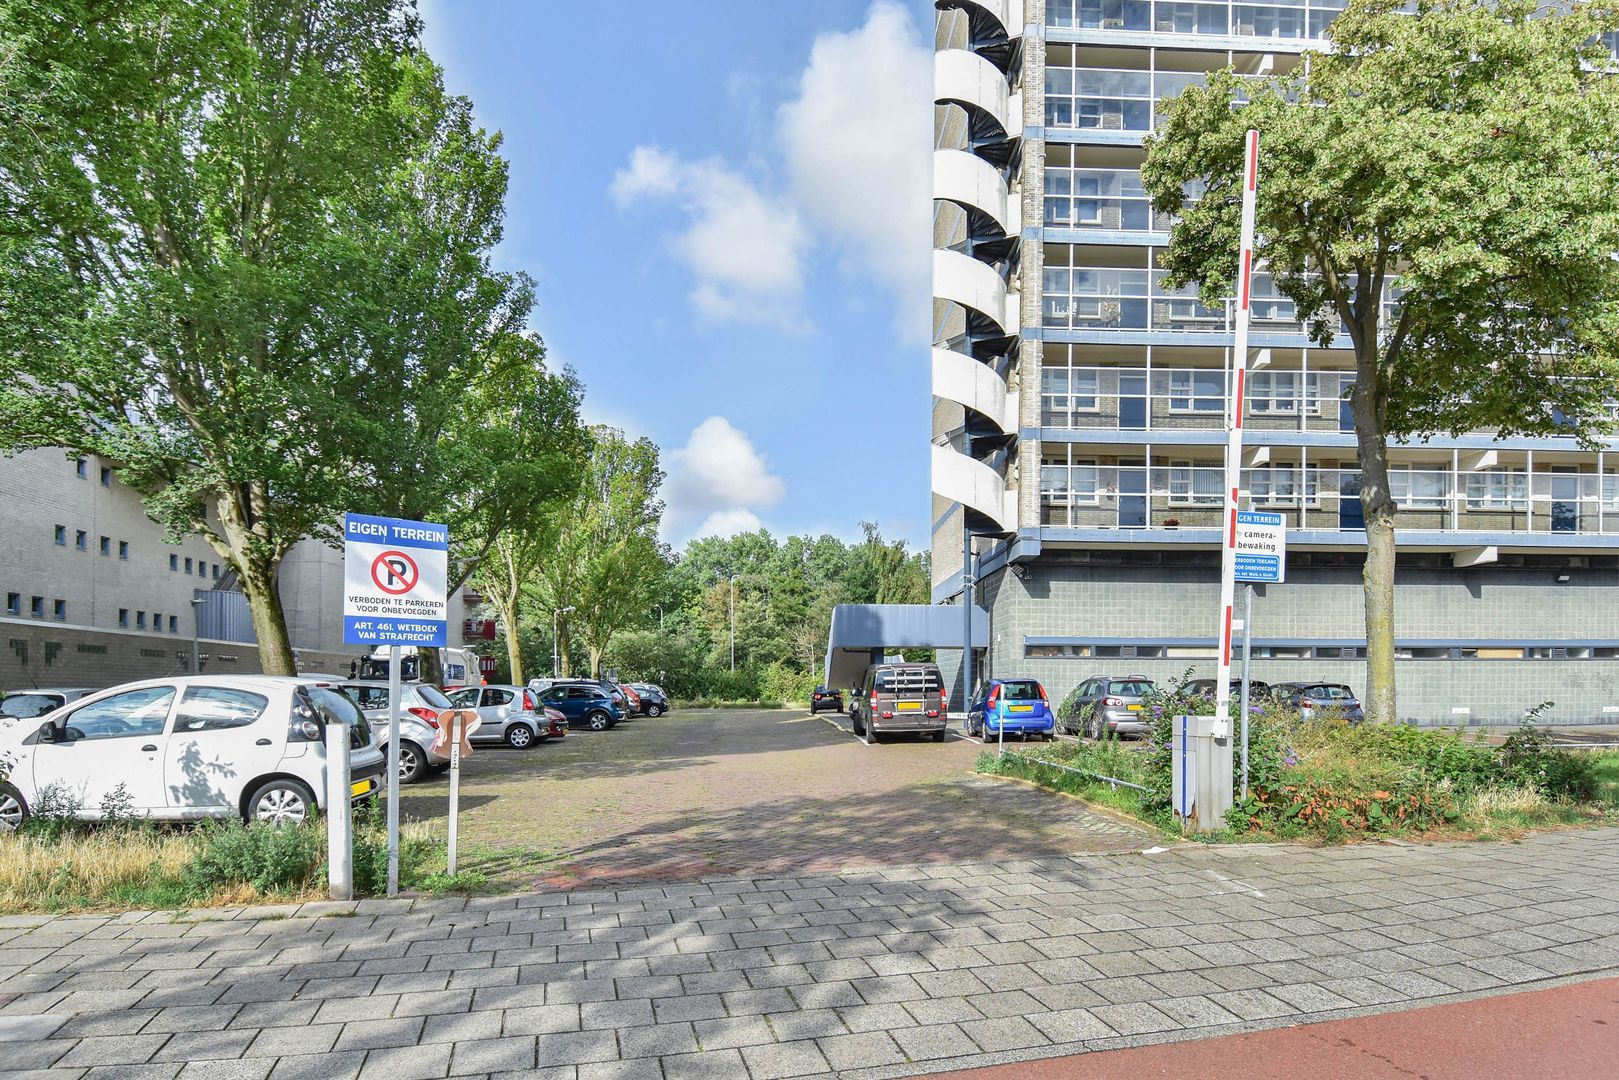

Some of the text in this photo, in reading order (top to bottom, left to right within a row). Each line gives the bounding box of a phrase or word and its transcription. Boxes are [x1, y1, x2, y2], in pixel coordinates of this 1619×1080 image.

[1253, 515, 1280, 524] TERREIN
[349, 521, 444, 543] EIGEN TERREIN
[1244, 531, 1276, 539] camera-
[1238, 541, 1276, 552] bewaking
[349, 596, 444, 608] VERBODEN TE PARKEREN
[356, 605, 437, 616] VOOR ONBEVOEGDEN
[354, 621, 374, 630] ART.
[397, 623, 438, 633] WETBOEK
[358, 631, 434, 642] VAN STRAFRECHT
